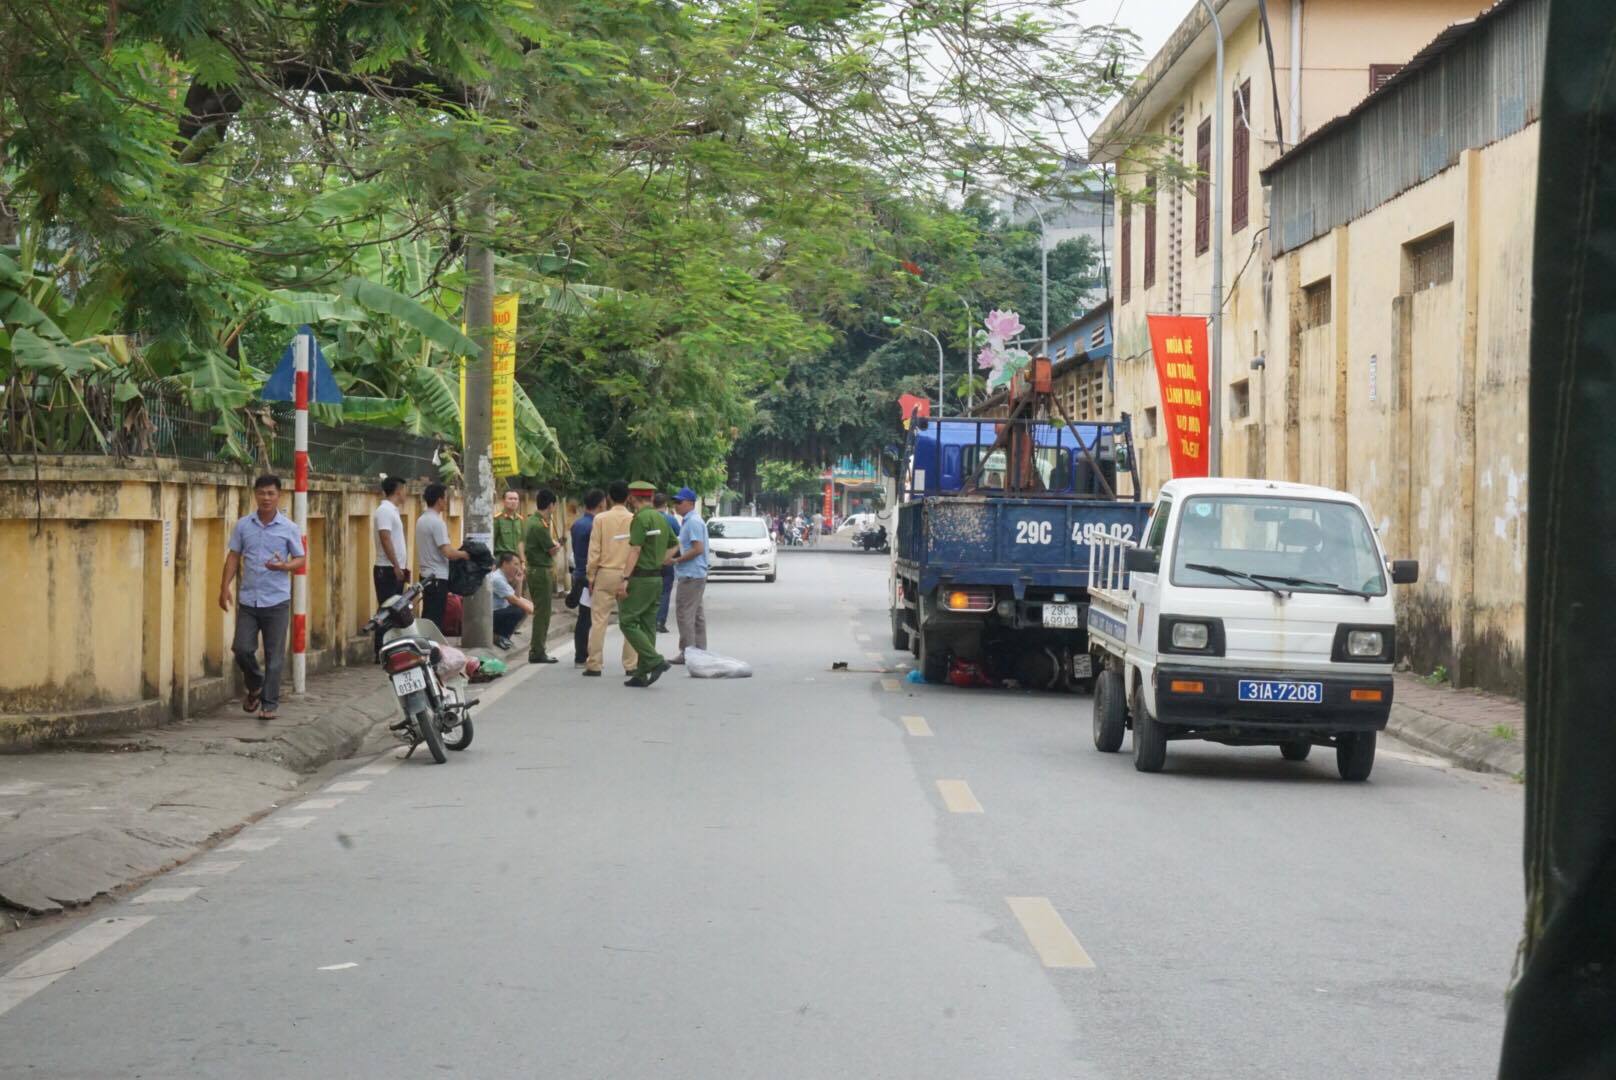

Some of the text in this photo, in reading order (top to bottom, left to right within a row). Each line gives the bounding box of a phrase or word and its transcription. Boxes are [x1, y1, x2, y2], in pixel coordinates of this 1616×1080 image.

[1166, 362, 1177, 379] AN
[1015, 520, 1053, 544] 29C
[1050, 605, 1069, 616] 29C
[1248, 683, 1317, 700] 31A-7208
